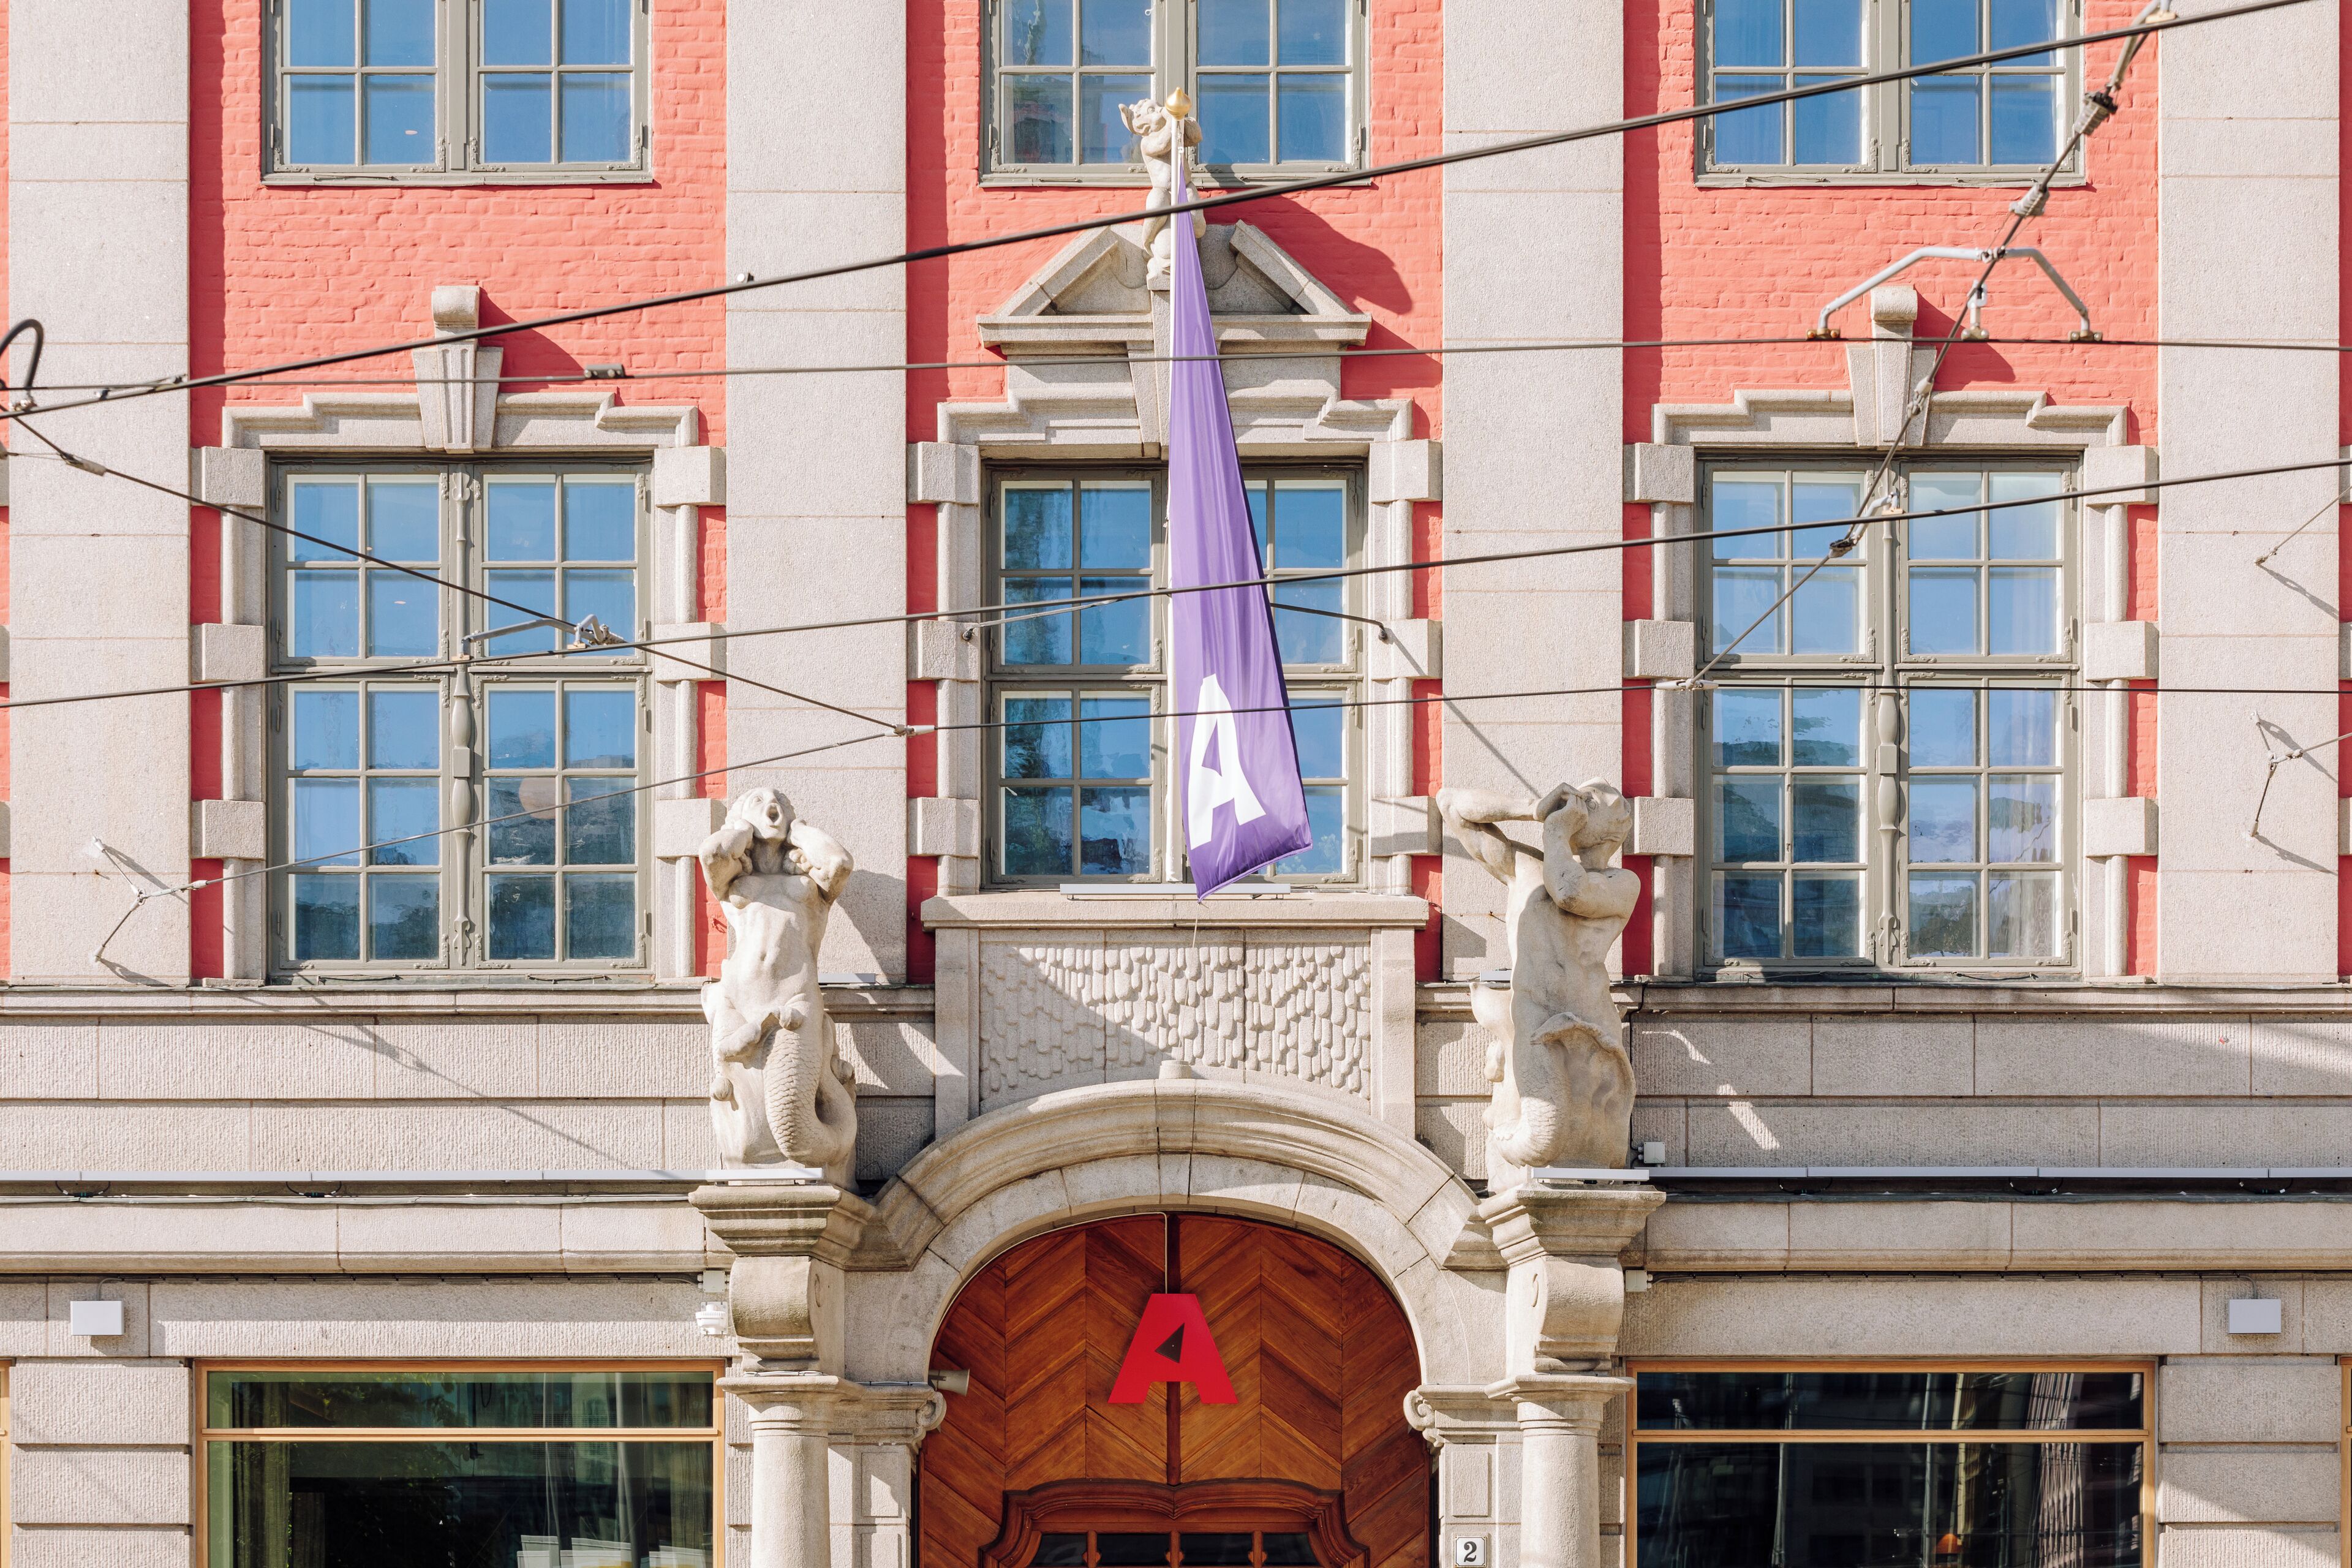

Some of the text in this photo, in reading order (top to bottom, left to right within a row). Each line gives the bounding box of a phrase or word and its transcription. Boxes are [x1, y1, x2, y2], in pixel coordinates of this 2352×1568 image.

[1188, 673, 1267, 850] A
[1107, 1293, 1238, 1404] A
[1463, 1541, 1477, 1562] 2
